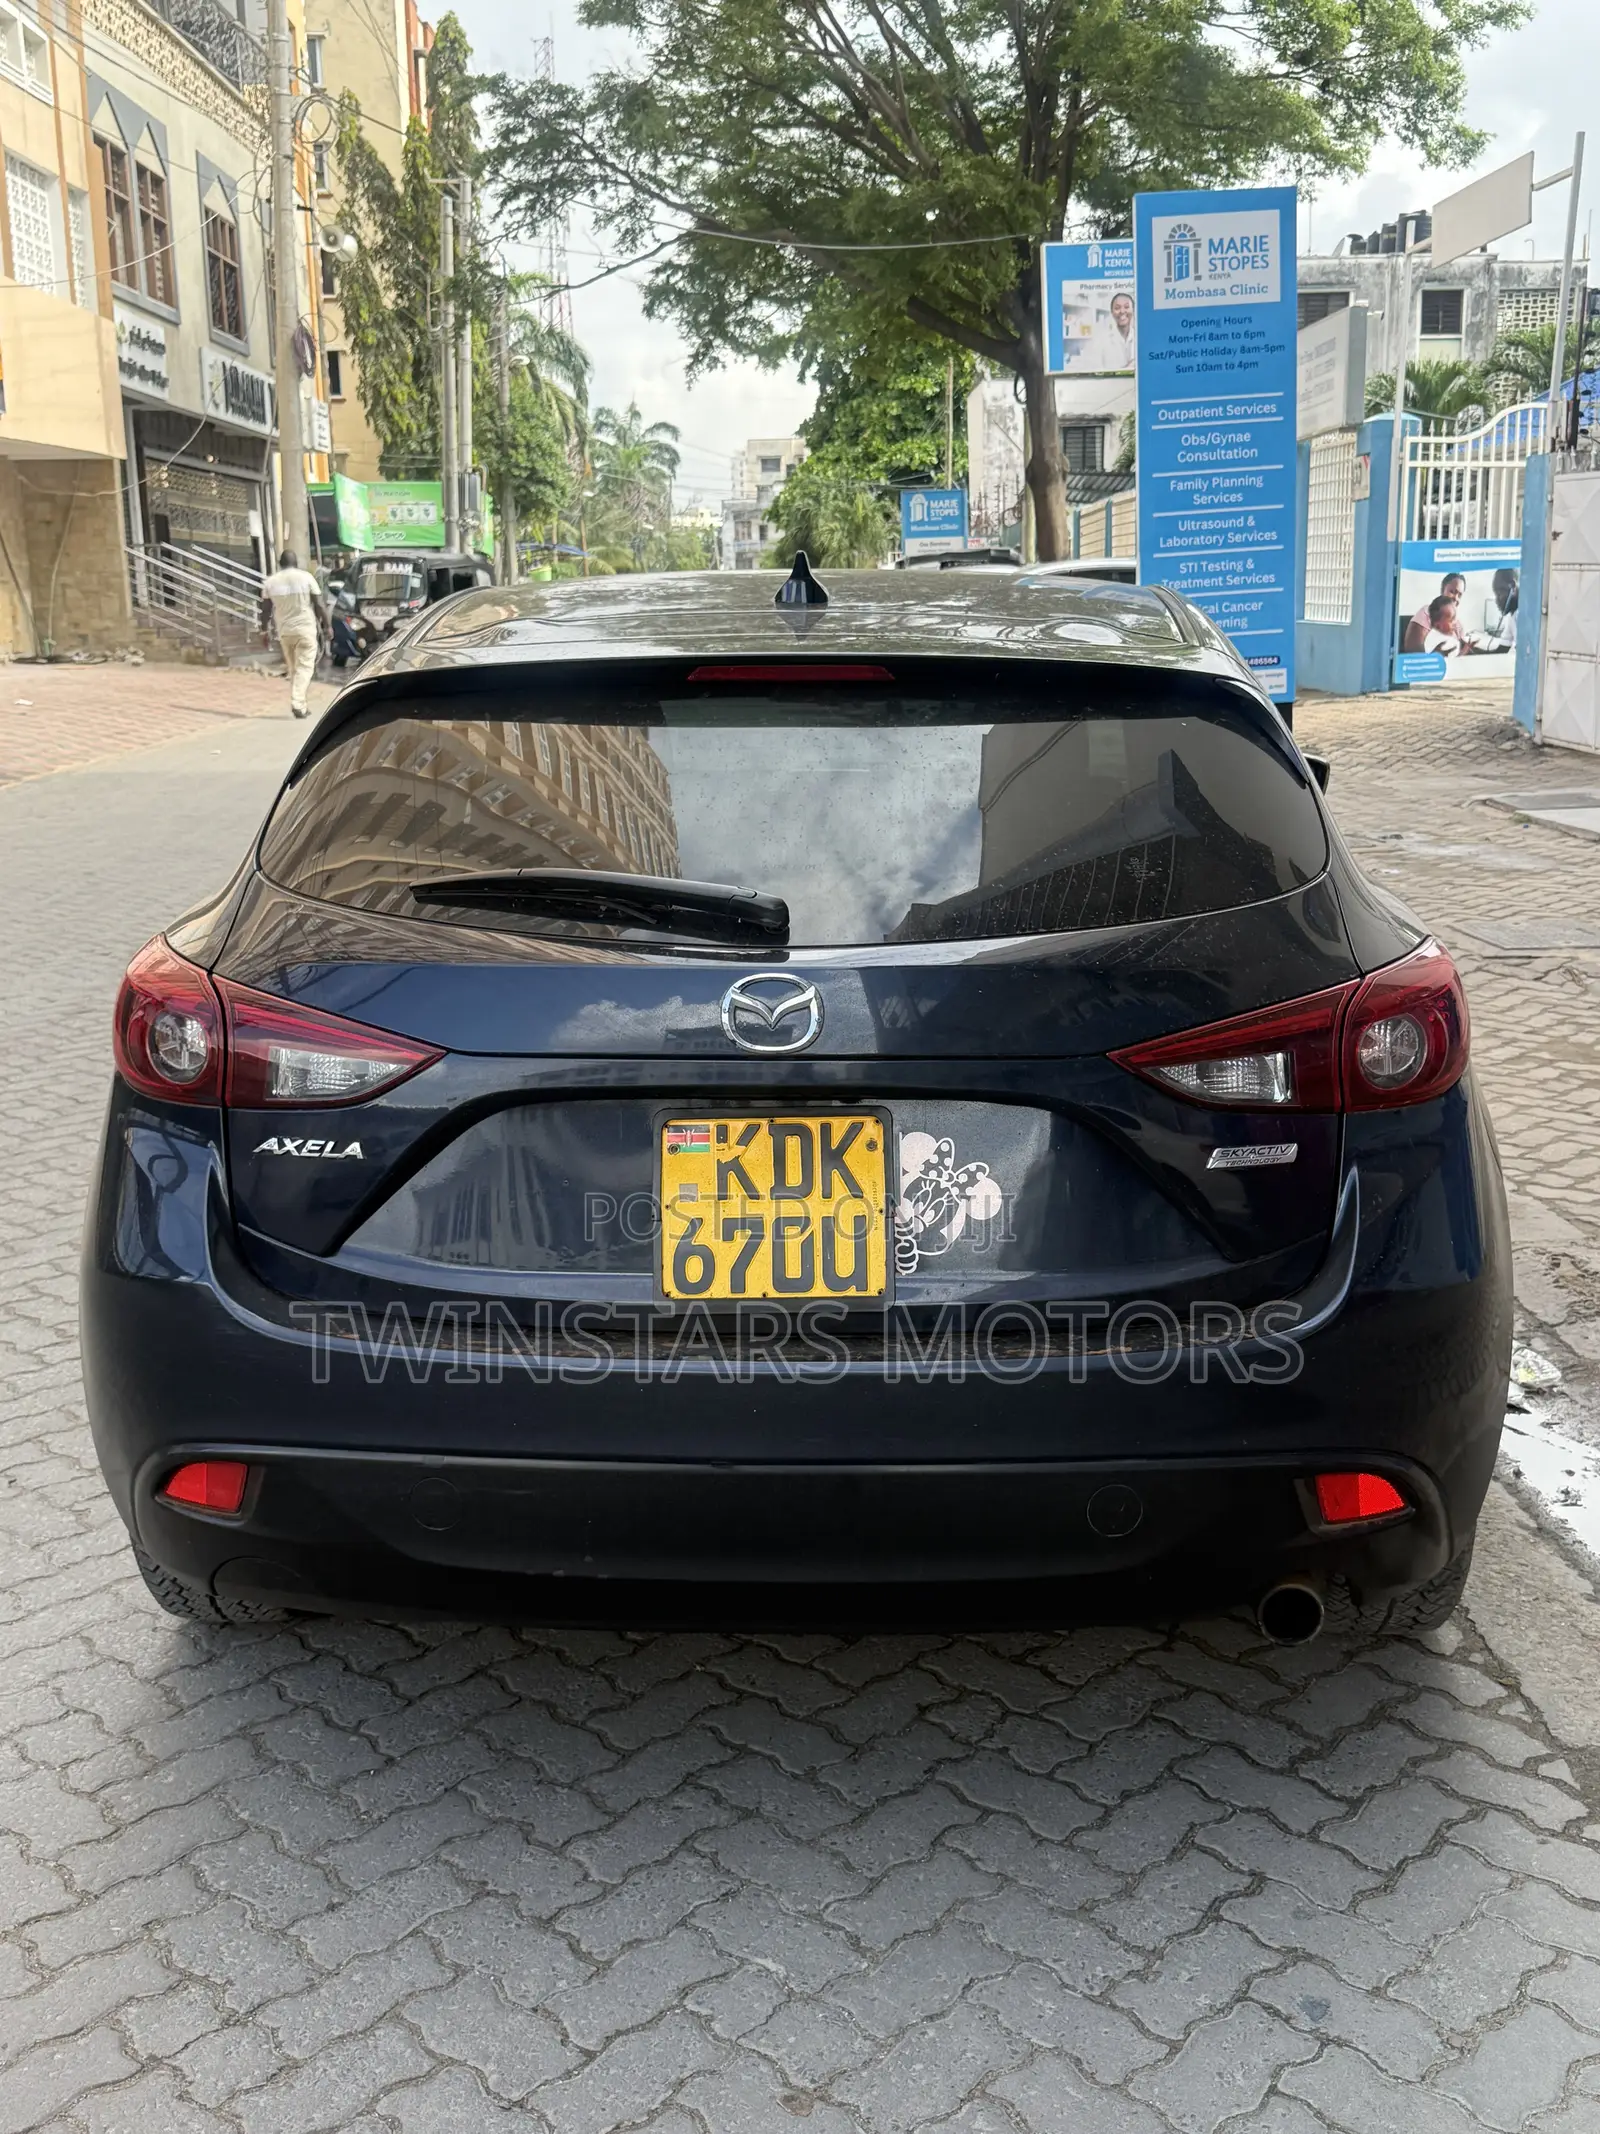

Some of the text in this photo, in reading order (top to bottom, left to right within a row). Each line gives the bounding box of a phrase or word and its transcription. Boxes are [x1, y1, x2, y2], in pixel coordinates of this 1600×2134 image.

[1104, 248, 1131, 258] MARIE
[1208, 235, 1269, 255] MARIE
[1104, 258, 1132, 268] KENYA
[1208, 254, 1269, 272] STOPES
[1208, 272, 1232, 280] KENYA
[1165, 283, 1268, 300] Mombasa Clinic
[1181, 315, 1252, 329] Opening Hours
[1168, 330, 1265, 343] Mon-Fri 8am to 6pm
[1148, 347, 1198, 361] Sat/Public
[1201, 346, 1237, 358] Holiday
[1239, 343, 1286, 355] 8am-5pm
[1175, 361, 1259, 374] Sun 10am to 4pm
[1158, 402, 1277, 422] Outpatient Services
[1181, 432, 1251, 447] Obs/Gynae
[1177, 447, 1258, 463] Consultation
[1170, 475, 1264, 492] Family Planning
[930, 499, 958, 509] MARIE
[1193, 492, 1243, 505] Services
[930, 508, 959, 517] STOPES
[1178, 515, 1256, 531] Ultrasound &
[1160, 530, 1278, 548] Laboratory Services
[1179, 558, 1255, 575] STI Testing &
[1162, 572, 1276, 590] Treatment Services
[1221, 601, 1264, 614] Cancer
[252, 1137, 364, 1160] AXELA
[1220, 1145, 1290, 1158] SKYACTIV
[715, 1122, 864, 1200] KDK
[1225, 1157, 1282, 1167] TECHNOLOGY
[673, 1214, 868, 1295] 670U
